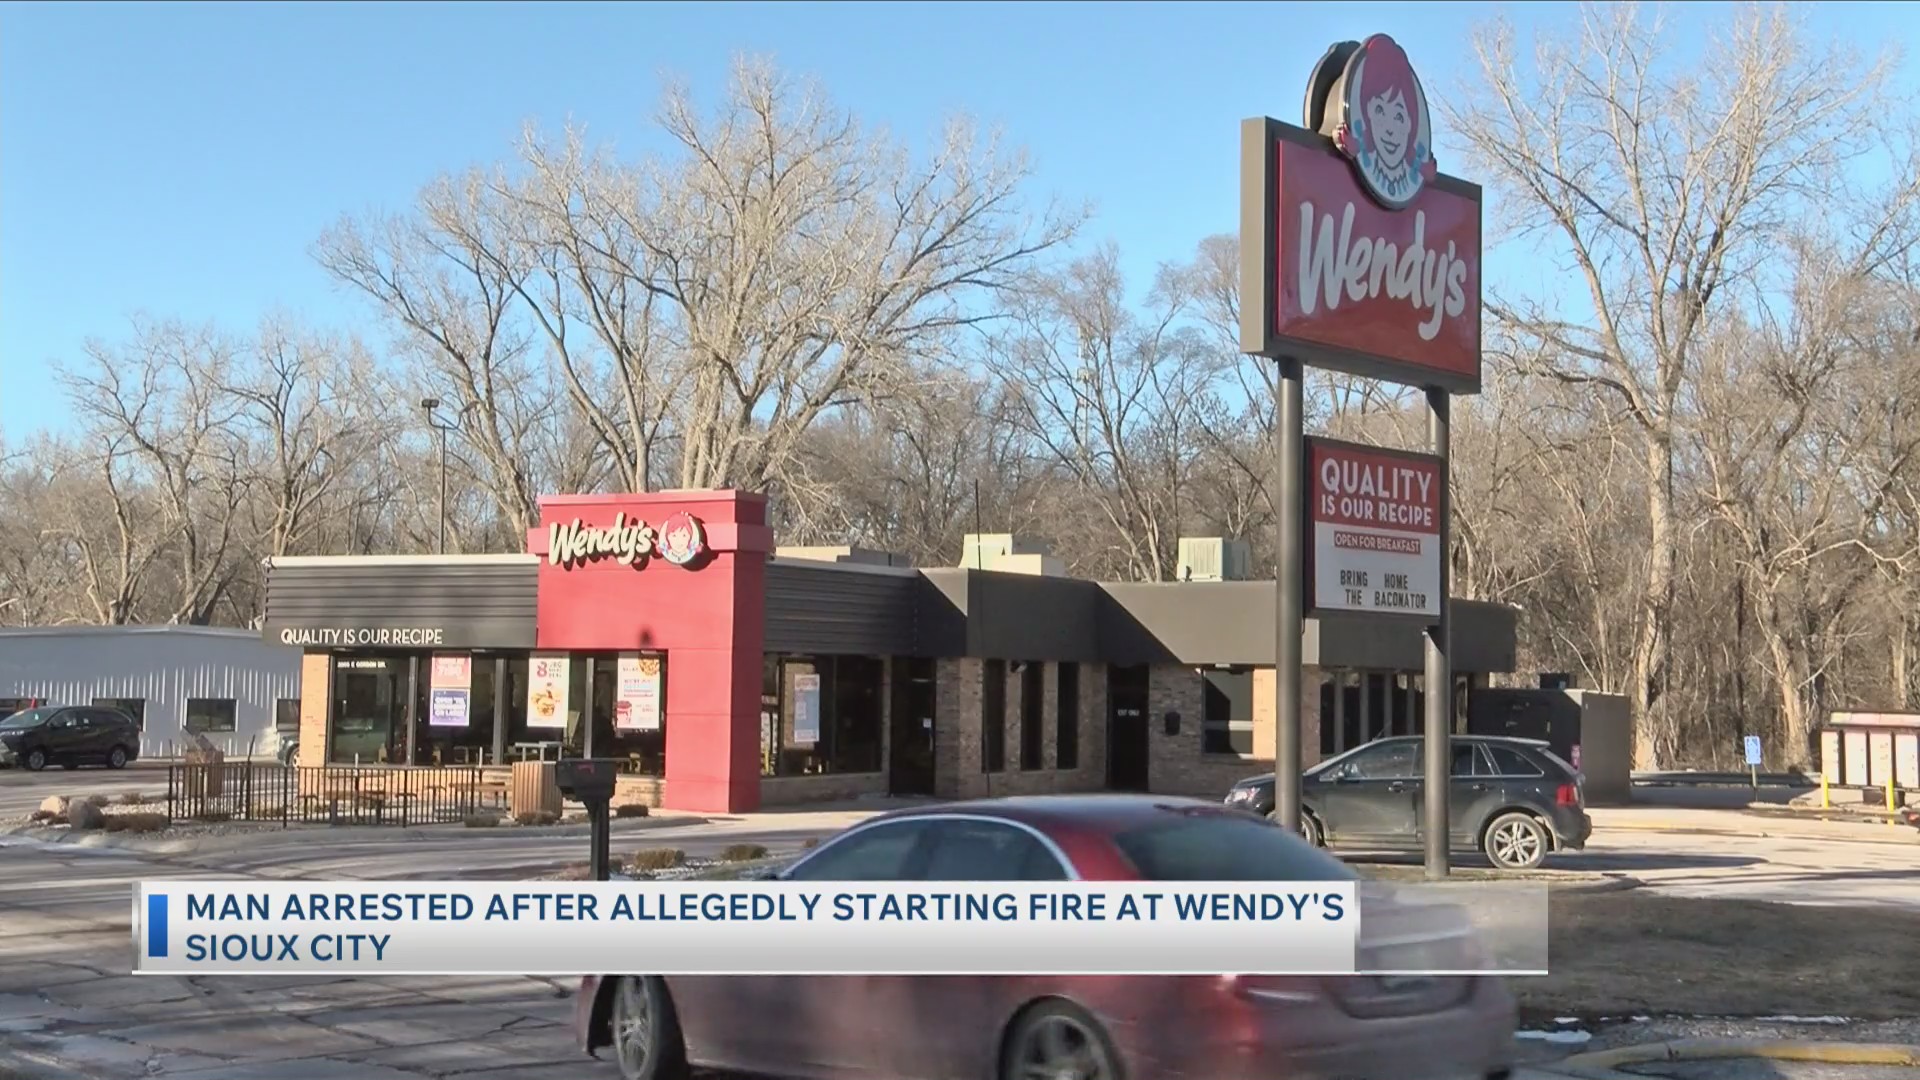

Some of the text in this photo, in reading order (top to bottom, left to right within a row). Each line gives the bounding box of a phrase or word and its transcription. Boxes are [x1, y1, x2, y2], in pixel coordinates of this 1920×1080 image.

[1299, 201, 1467, 341] Wendy's
[1321, 458, 1432, 503] QUALITY
[1321, 494, 1432, 527] IS OUR RECIPE
[549, 511, 653, 566] Wendy's
[1335, 533, 1420, 553] OPEN FOR BREAKFAST
[1340, 569, 1408, 590] BRING HOME
[1345, 588, 1427, 608] THE BACONATOR
[281, 628, 443, 645] QUALITY IS OUR RECIPE
